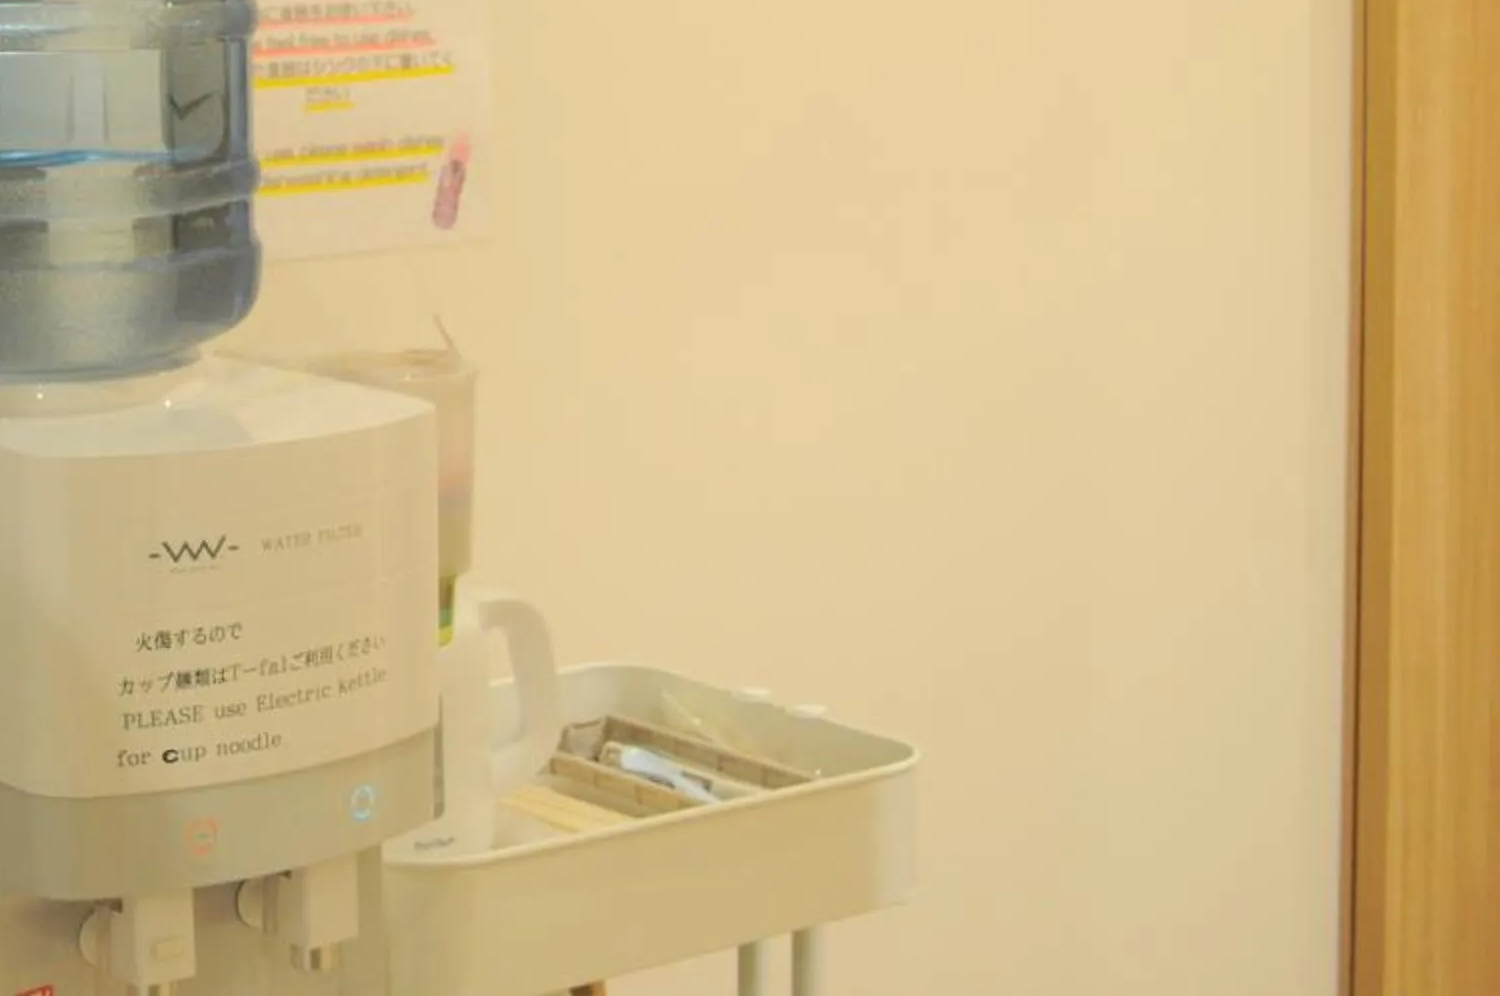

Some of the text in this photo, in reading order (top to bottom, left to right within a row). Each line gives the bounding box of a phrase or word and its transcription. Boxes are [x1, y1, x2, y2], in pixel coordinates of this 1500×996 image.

[122, 667, 388, 731] PLEASE use Electric kettle
[116, 748, 152, 769] for
[216, 730, 283, 757] noodle
